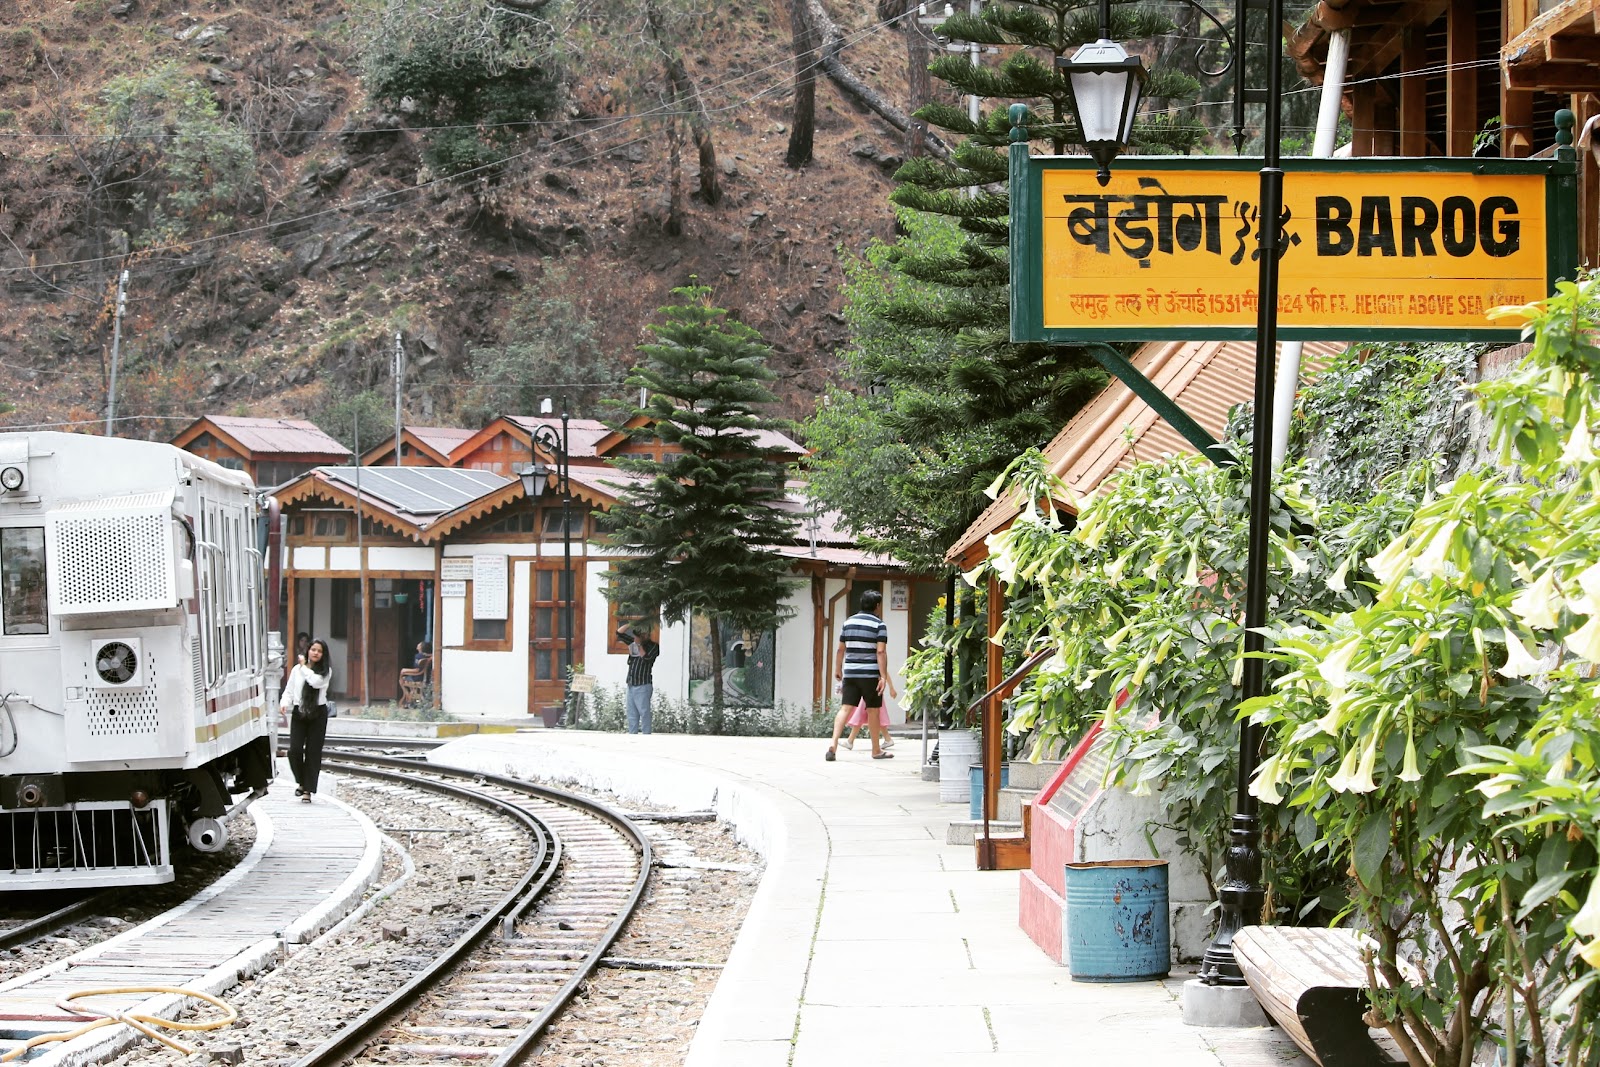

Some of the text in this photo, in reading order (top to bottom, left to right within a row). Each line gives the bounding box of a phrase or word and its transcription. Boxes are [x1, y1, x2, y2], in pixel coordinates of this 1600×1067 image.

[1316, 195, 1520, 258] BAROG
[1115, 294, 1142, 317] तल
[1146, 287, 1162, 315] से
[1208, 294, 1241, 313] 1531
[1276, 294, 1304, 314] 024
[1408, 294, 1454, 315] ABOVE
[1458, 294, 1485, 315] SEA
